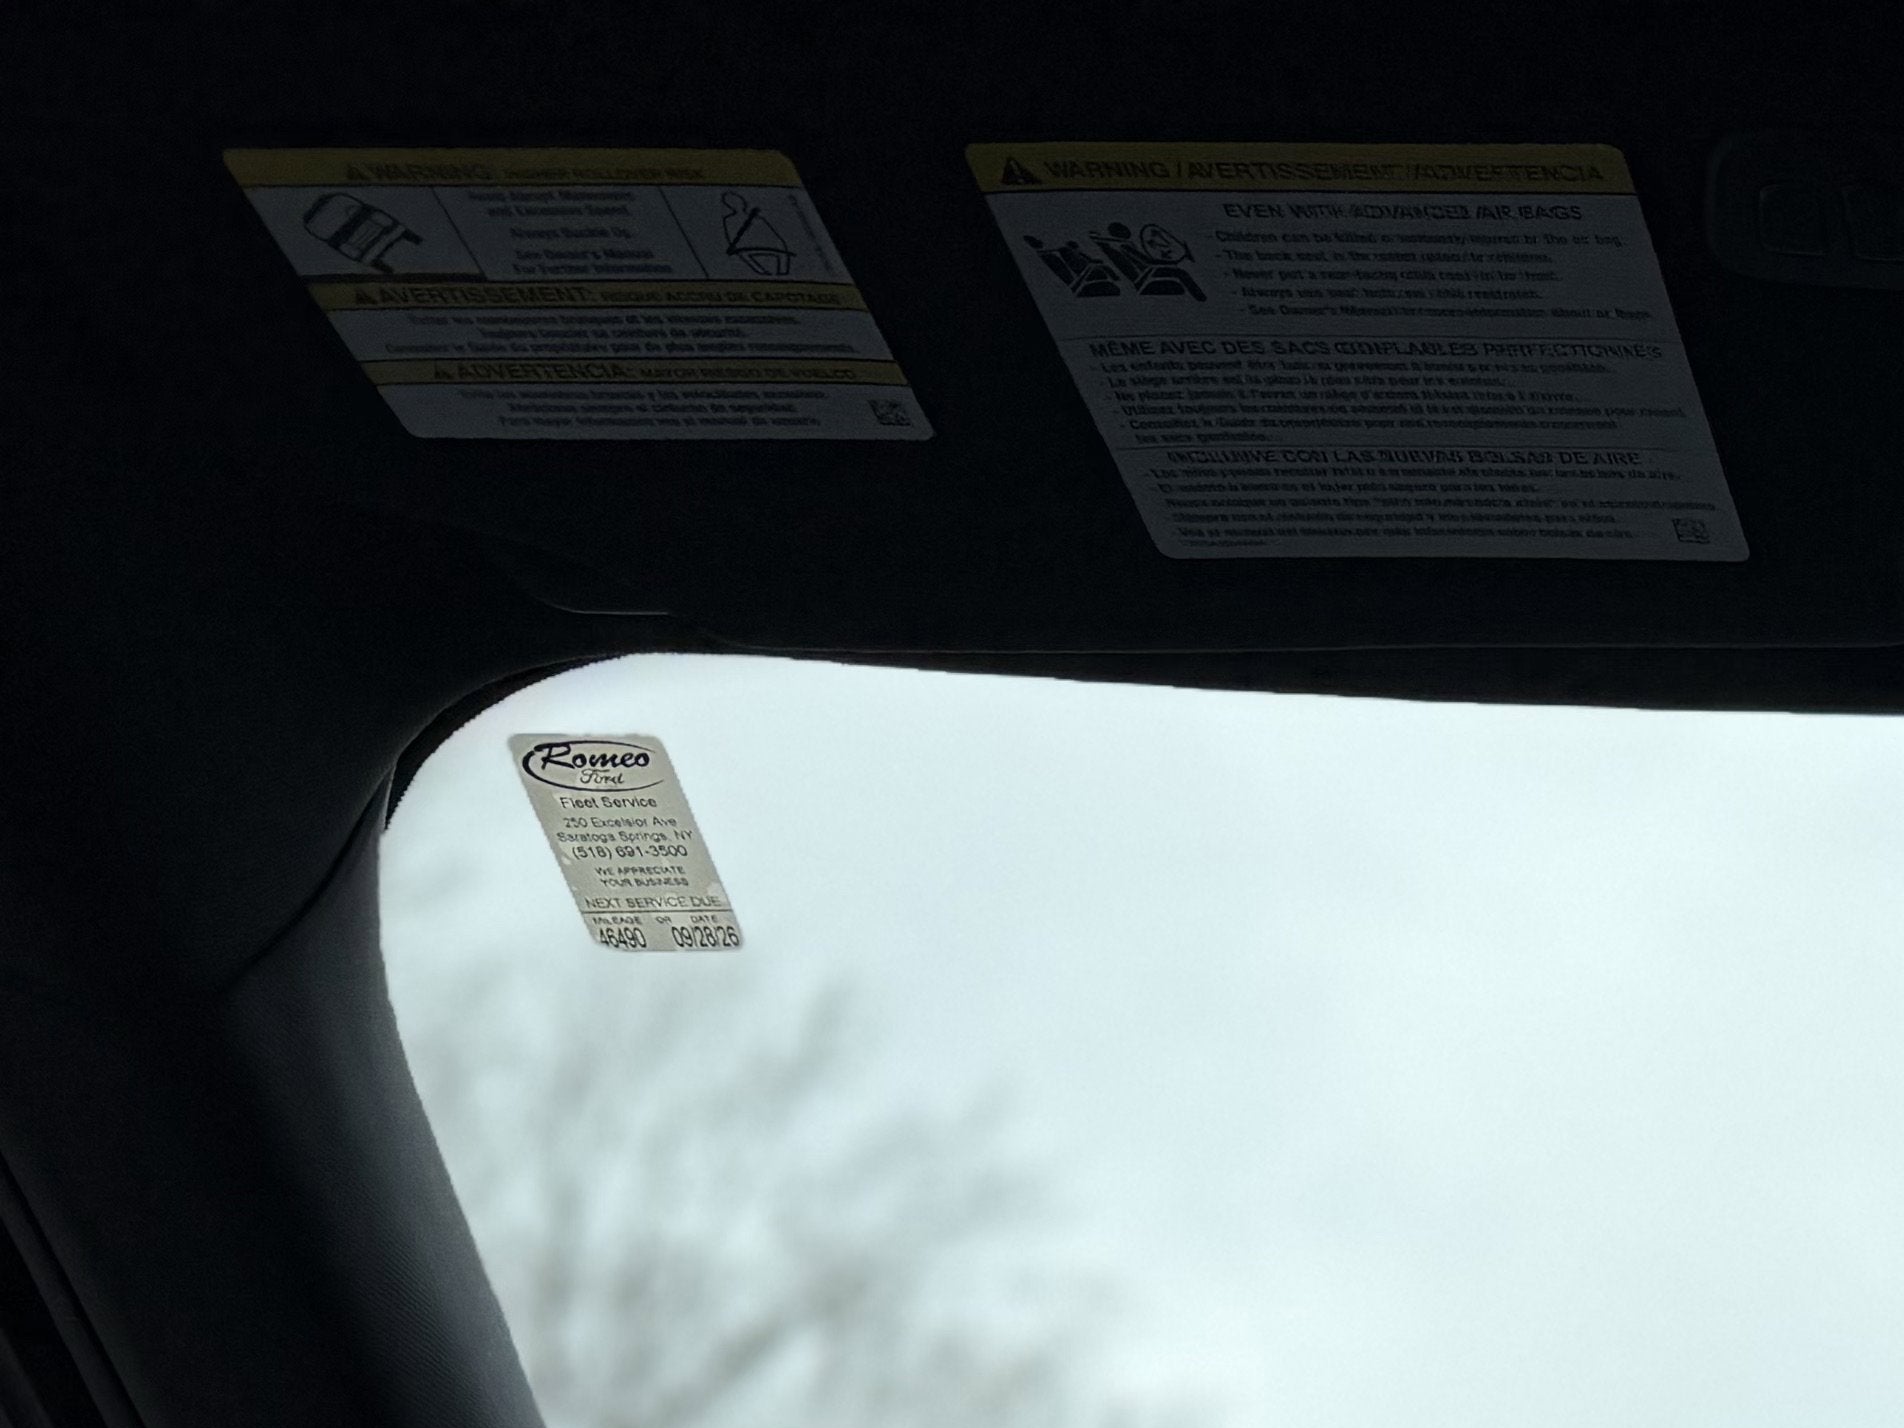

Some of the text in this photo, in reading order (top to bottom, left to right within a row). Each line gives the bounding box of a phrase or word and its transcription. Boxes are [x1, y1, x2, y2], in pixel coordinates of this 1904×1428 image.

[1044, 161, 1169, 178] WARNING
[1223, 203, 1284, 218] EVEN
[1518, 205, 1583, 221] BAGS
[1159, 340, 1216, 355] AVEC
[1221, 341, 1266, 355] DES
[1271, 340, 1331, 355] SACS
[1559, 451, 1589, 465] DE
[534, 742, 651, 770] Romeo
[579, 769, 625, 784] Ford
[560, 796, 658, 810] Fleet Service
[591, 817, 649, 829] Excelsior
[652, 817, 677, 828] Ave
[557, 832, 616, 845] Saratoga
[674, 830, 693, 841] NY
[571, 845, 688, 861] (518) 691-3500
[595, 866, 686, 876] WE APPRECIATE
[600, 877, 689, 888] YOUR BUSINESS
[584, 895, 722, 909] NEXT SERVICE DUE
[592, 916, 643, 926] MILEAGE
[690, 915, 718, 925] DATE
[671, 926, 741, 948] 09/28/26
